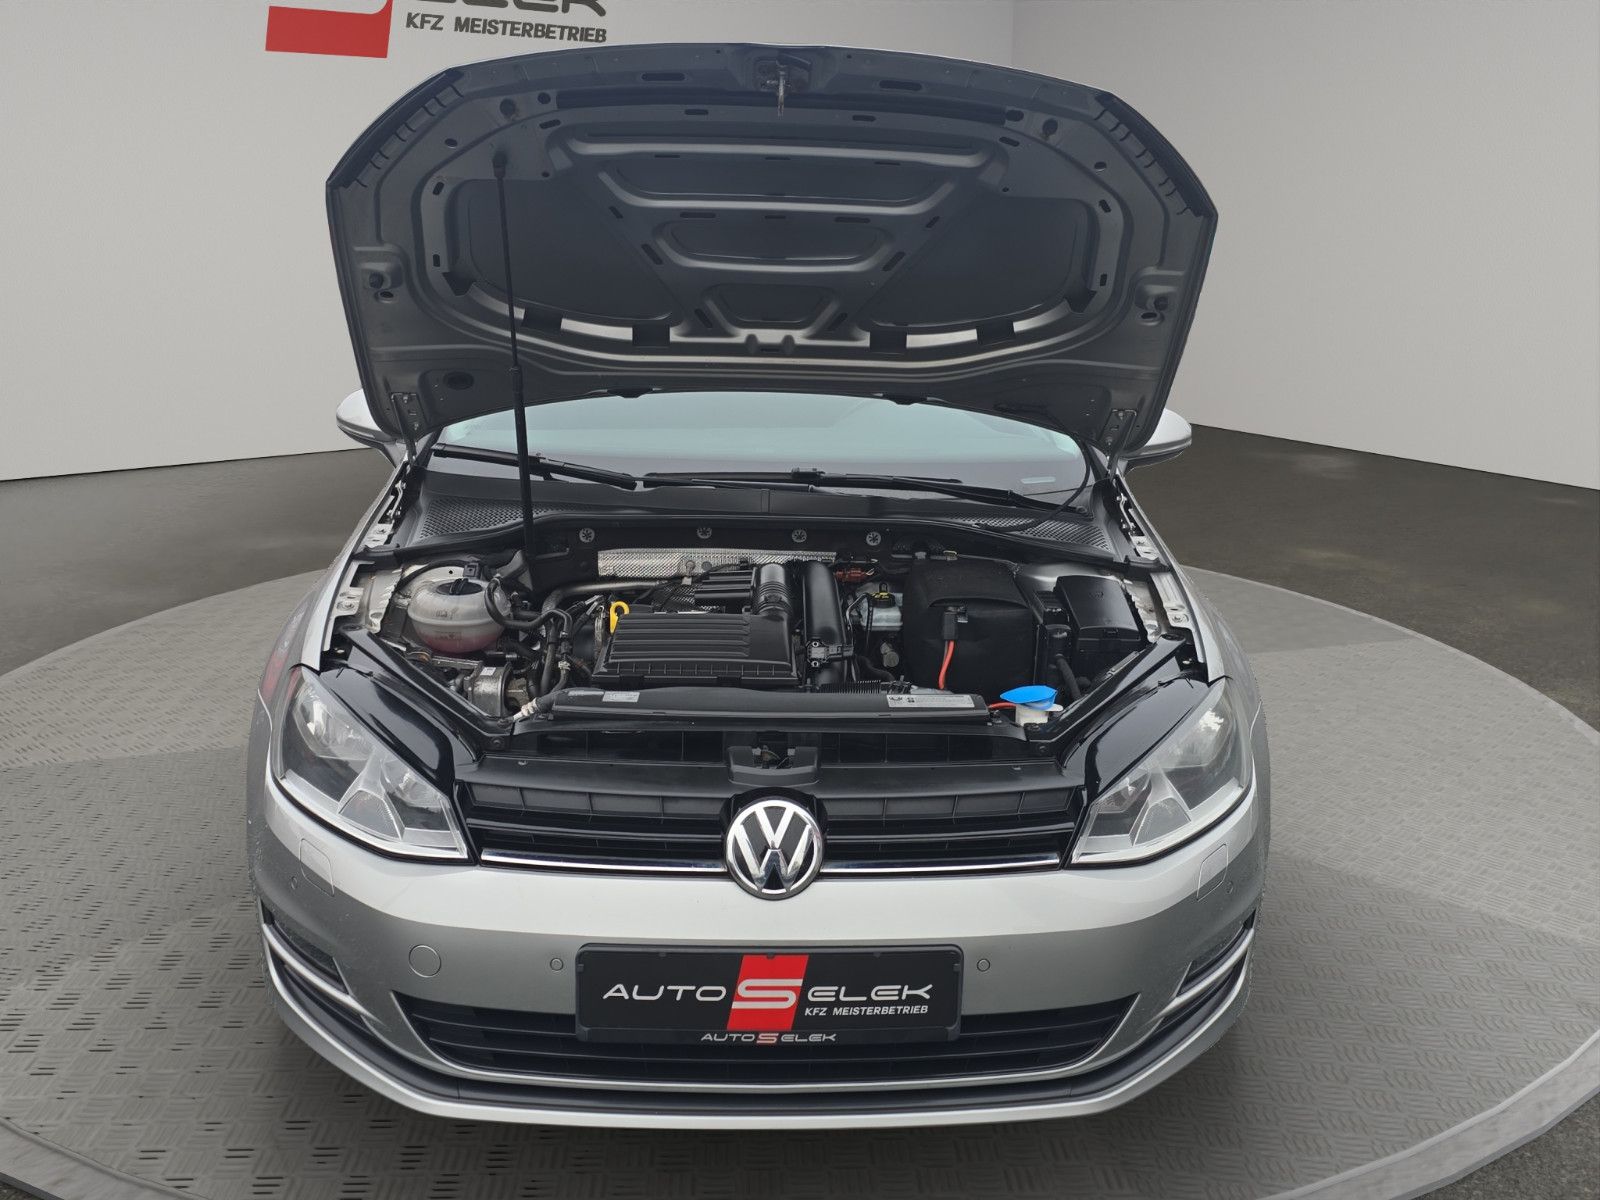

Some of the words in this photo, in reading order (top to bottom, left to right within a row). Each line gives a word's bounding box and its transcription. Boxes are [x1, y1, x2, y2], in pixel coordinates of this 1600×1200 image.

[405, 12, 444, 31] KFZ
[454, 16, 607, 43] MEISTERBETRIEB
[804, 1007, 827, 1016] KFZ
[832, 1005, 929, 1016] MEISTERBETRIEB
